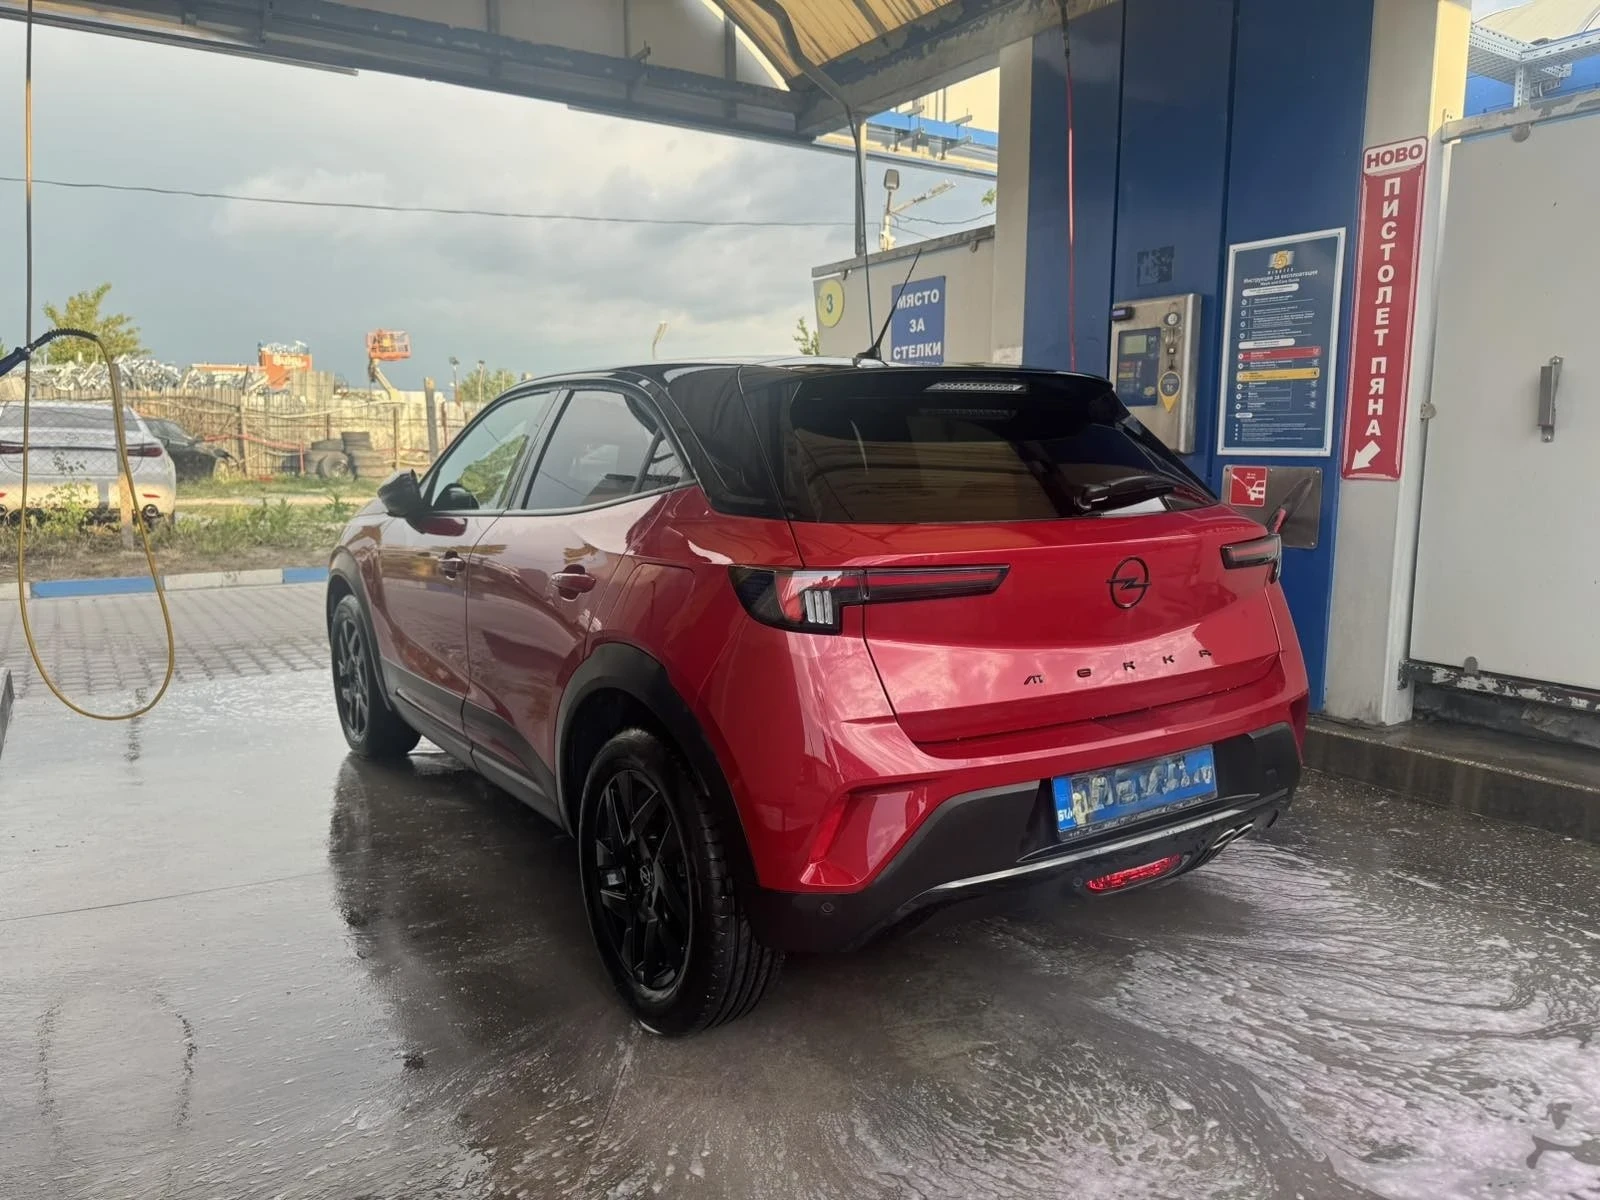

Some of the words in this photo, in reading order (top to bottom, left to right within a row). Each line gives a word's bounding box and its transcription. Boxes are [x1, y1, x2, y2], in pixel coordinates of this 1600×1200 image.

[1366, 143, 1423, 169] НОВО
[1374, 176, 1401, 346] ПИСТОЛЕТ
[826, 293, 834, 314] 3
[897, 288, 940, 310] МЯСТО
[909, 317, 926, 333] ЗА
[893, 341, 942, 360] СТЕЛКИ
[1365, 356, 1387, 436] ПЯНА
[1024, 649, 1212, 686] MOKKA
